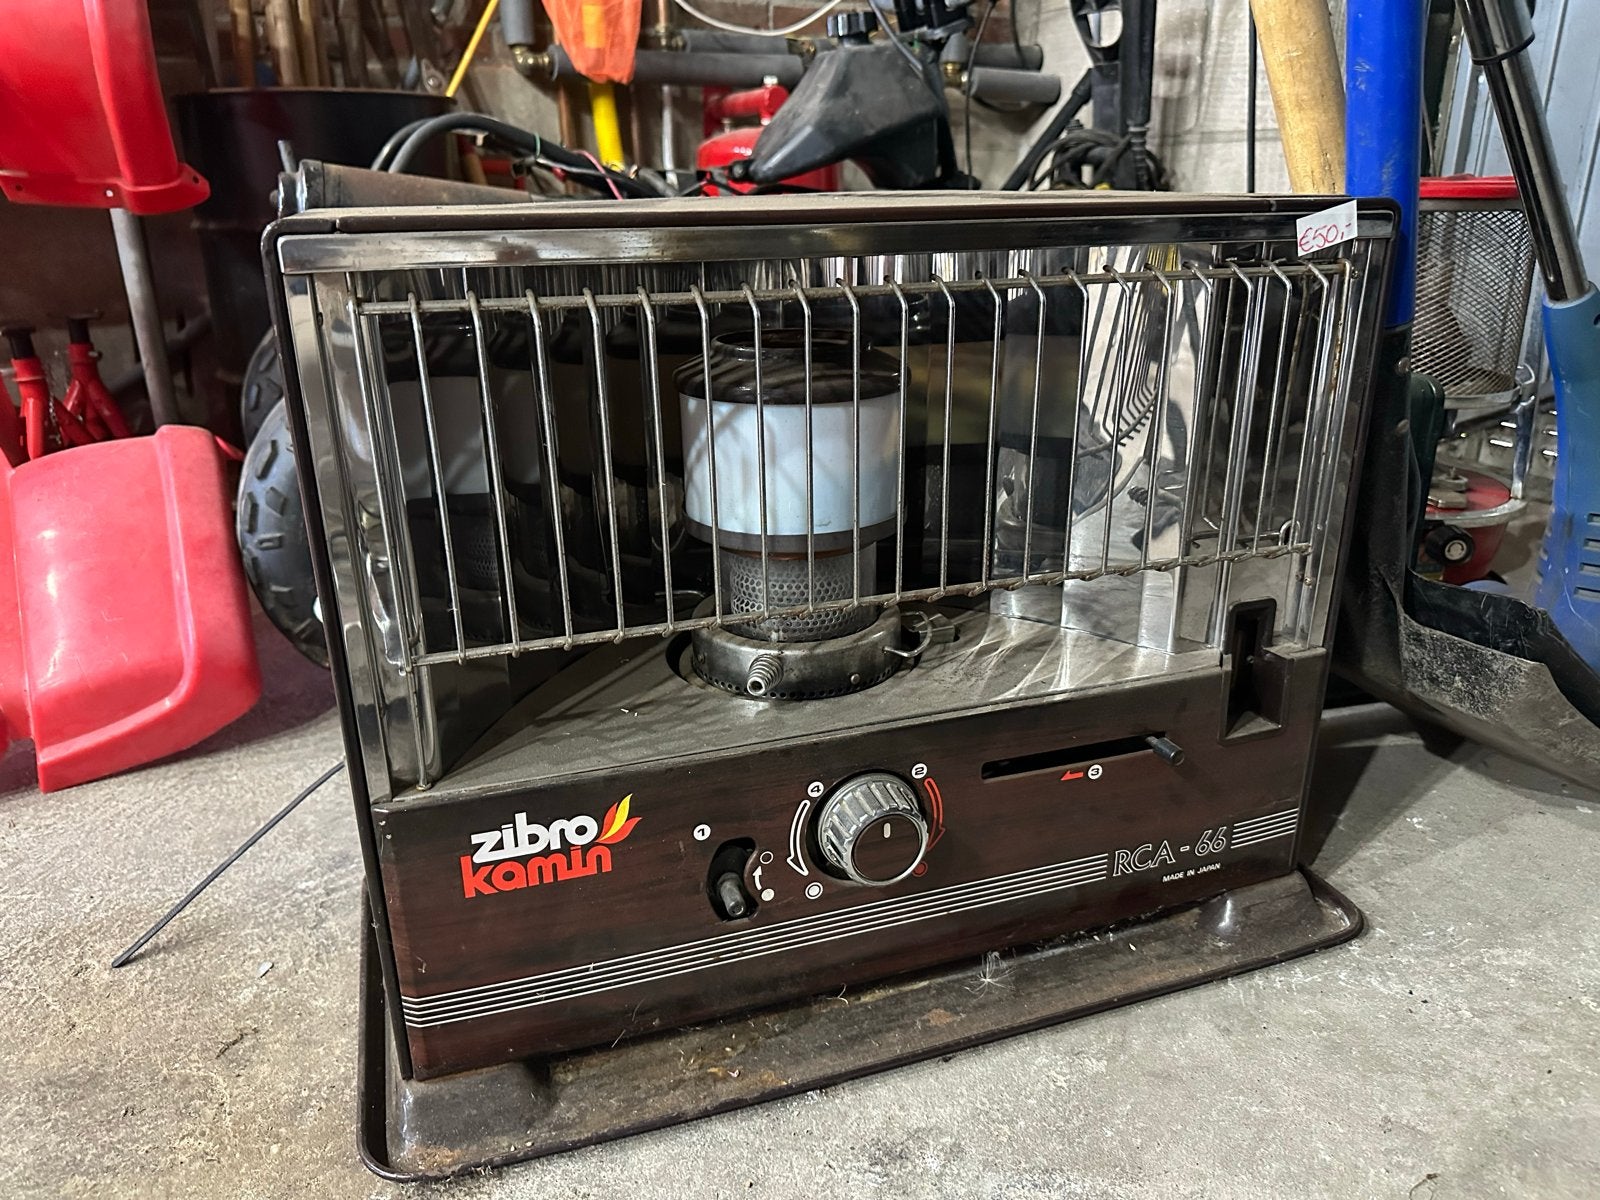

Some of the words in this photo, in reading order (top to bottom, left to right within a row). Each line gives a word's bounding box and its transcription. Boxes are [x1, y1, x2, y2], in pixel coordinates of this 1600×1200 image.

[1298, 222, 1352, 252] €50,-
[470, 811, 599, 864] zibro
[1112, 840, 1176, 877] RCA
[1194, 826, 1227, 857] 66
[459, 845, 613, 899] kamin
[1162, 871, 1185, 883] MADE
[1187, 868, 1195, 877] IN
[1196, 862, 1221, 875] JAPAN
